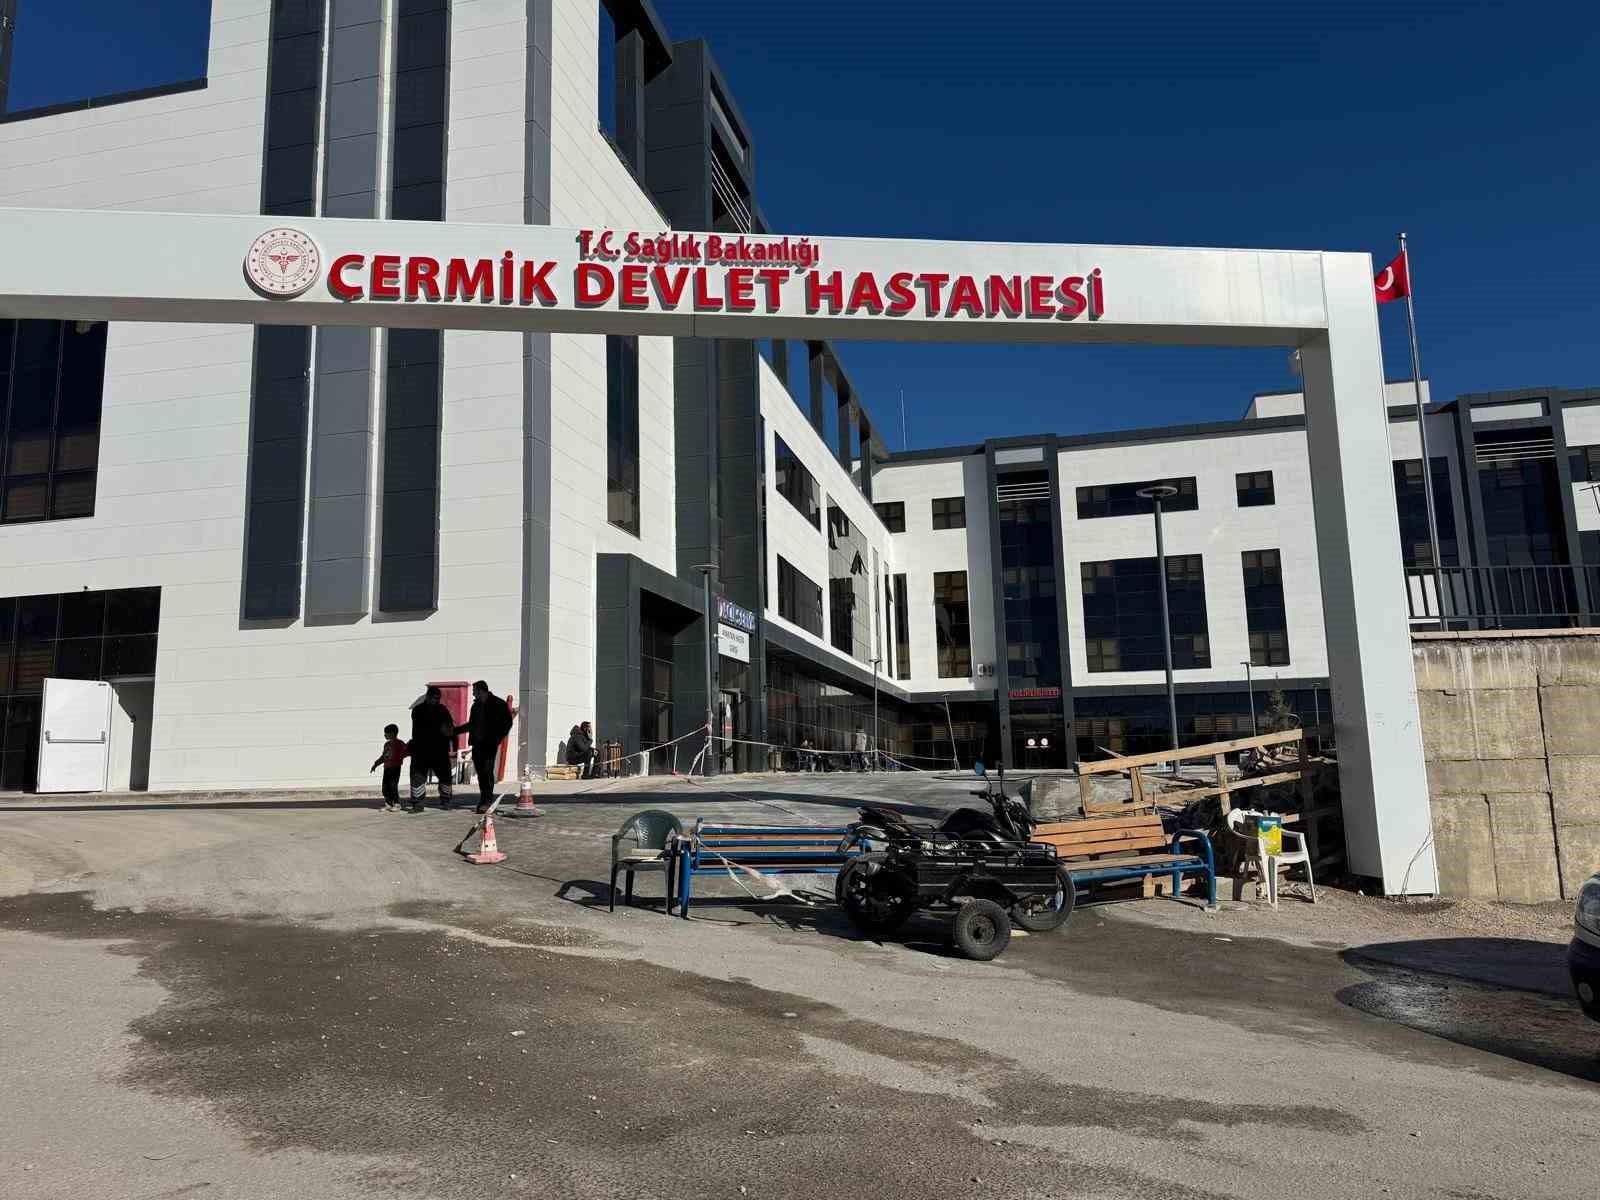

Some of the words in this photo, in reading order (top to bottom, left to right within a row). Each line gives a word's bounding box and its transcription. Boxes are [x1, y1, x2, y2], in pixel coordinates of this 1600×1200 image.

[578, 229, 621, 256] T.C.
[628, 230, 701, 264] Sağlık
[707, 235, 820, 267] Bakanlığı
[575, 261, 790, 309] DEVLET
[808, 266, 1105, 317] HASTANESİ
